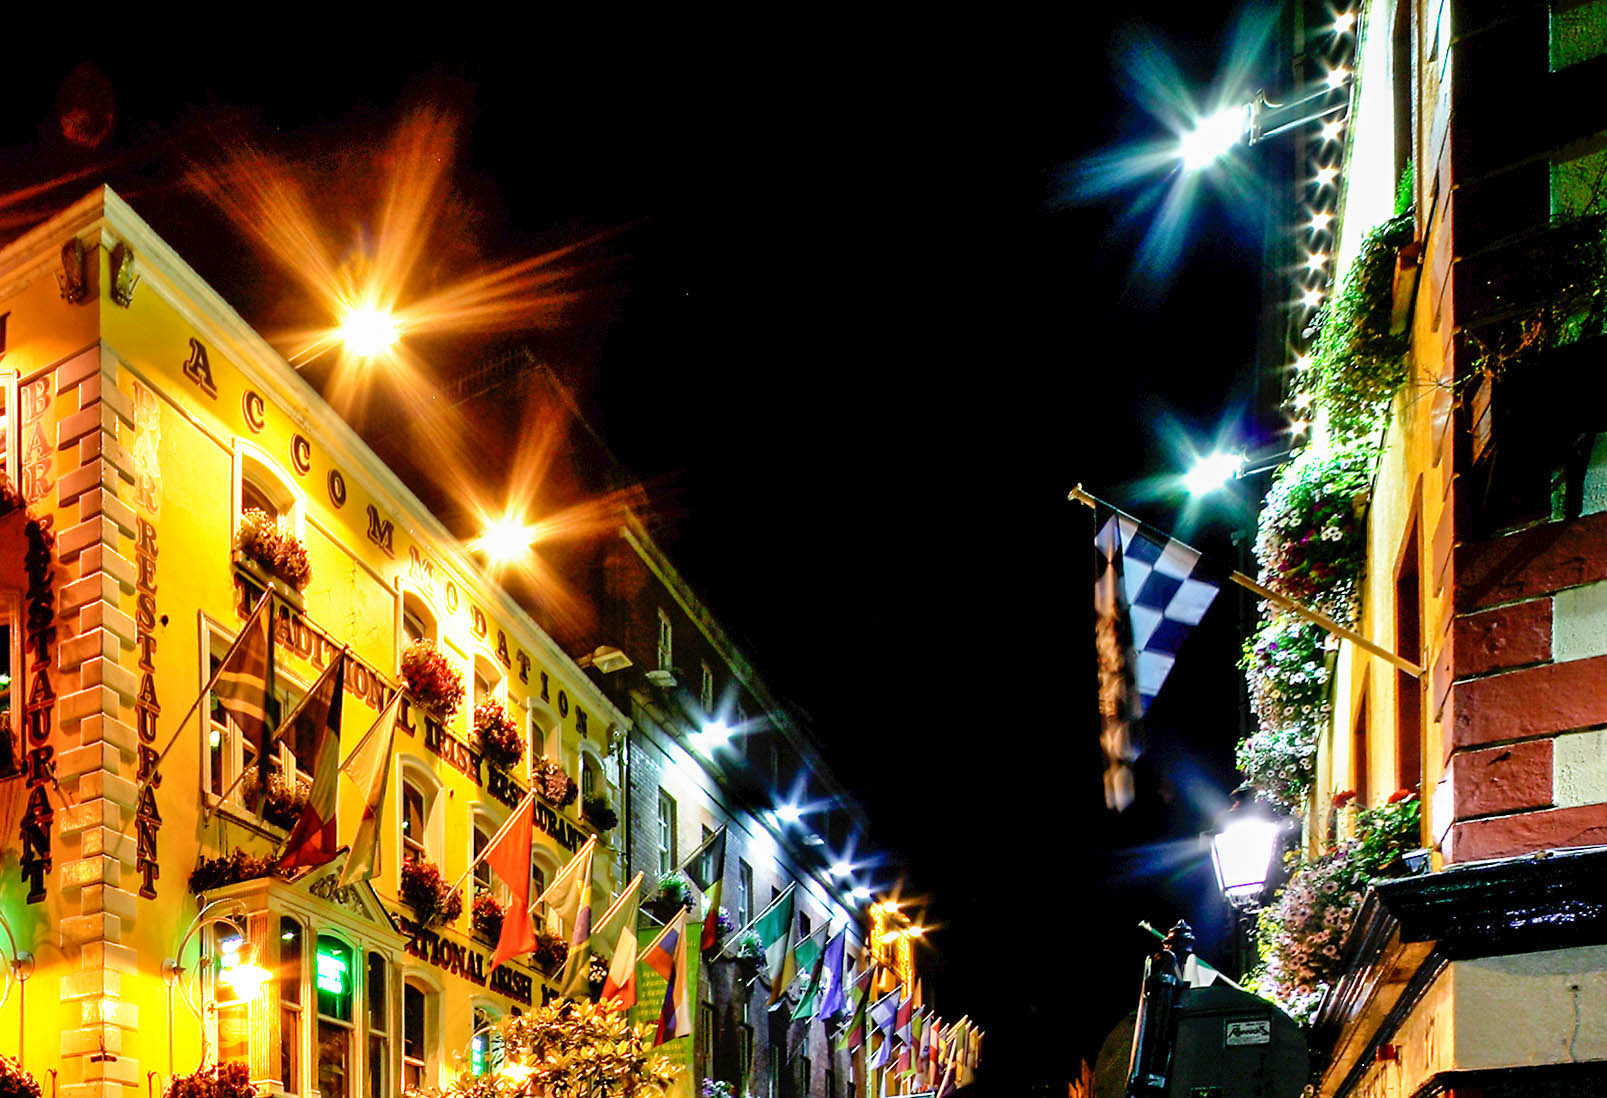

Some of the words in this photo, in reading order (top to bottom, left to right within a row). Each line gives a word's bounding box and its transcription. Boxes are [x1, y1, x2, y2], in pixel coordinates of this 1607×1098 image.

[21, 376, 54, 506] BAR
[182, 336, 589, 739] ACCOMMODATION
[21, 513, 56, 905] RESTAURANT
[135, 516, 163, 901] RESTAURANT
